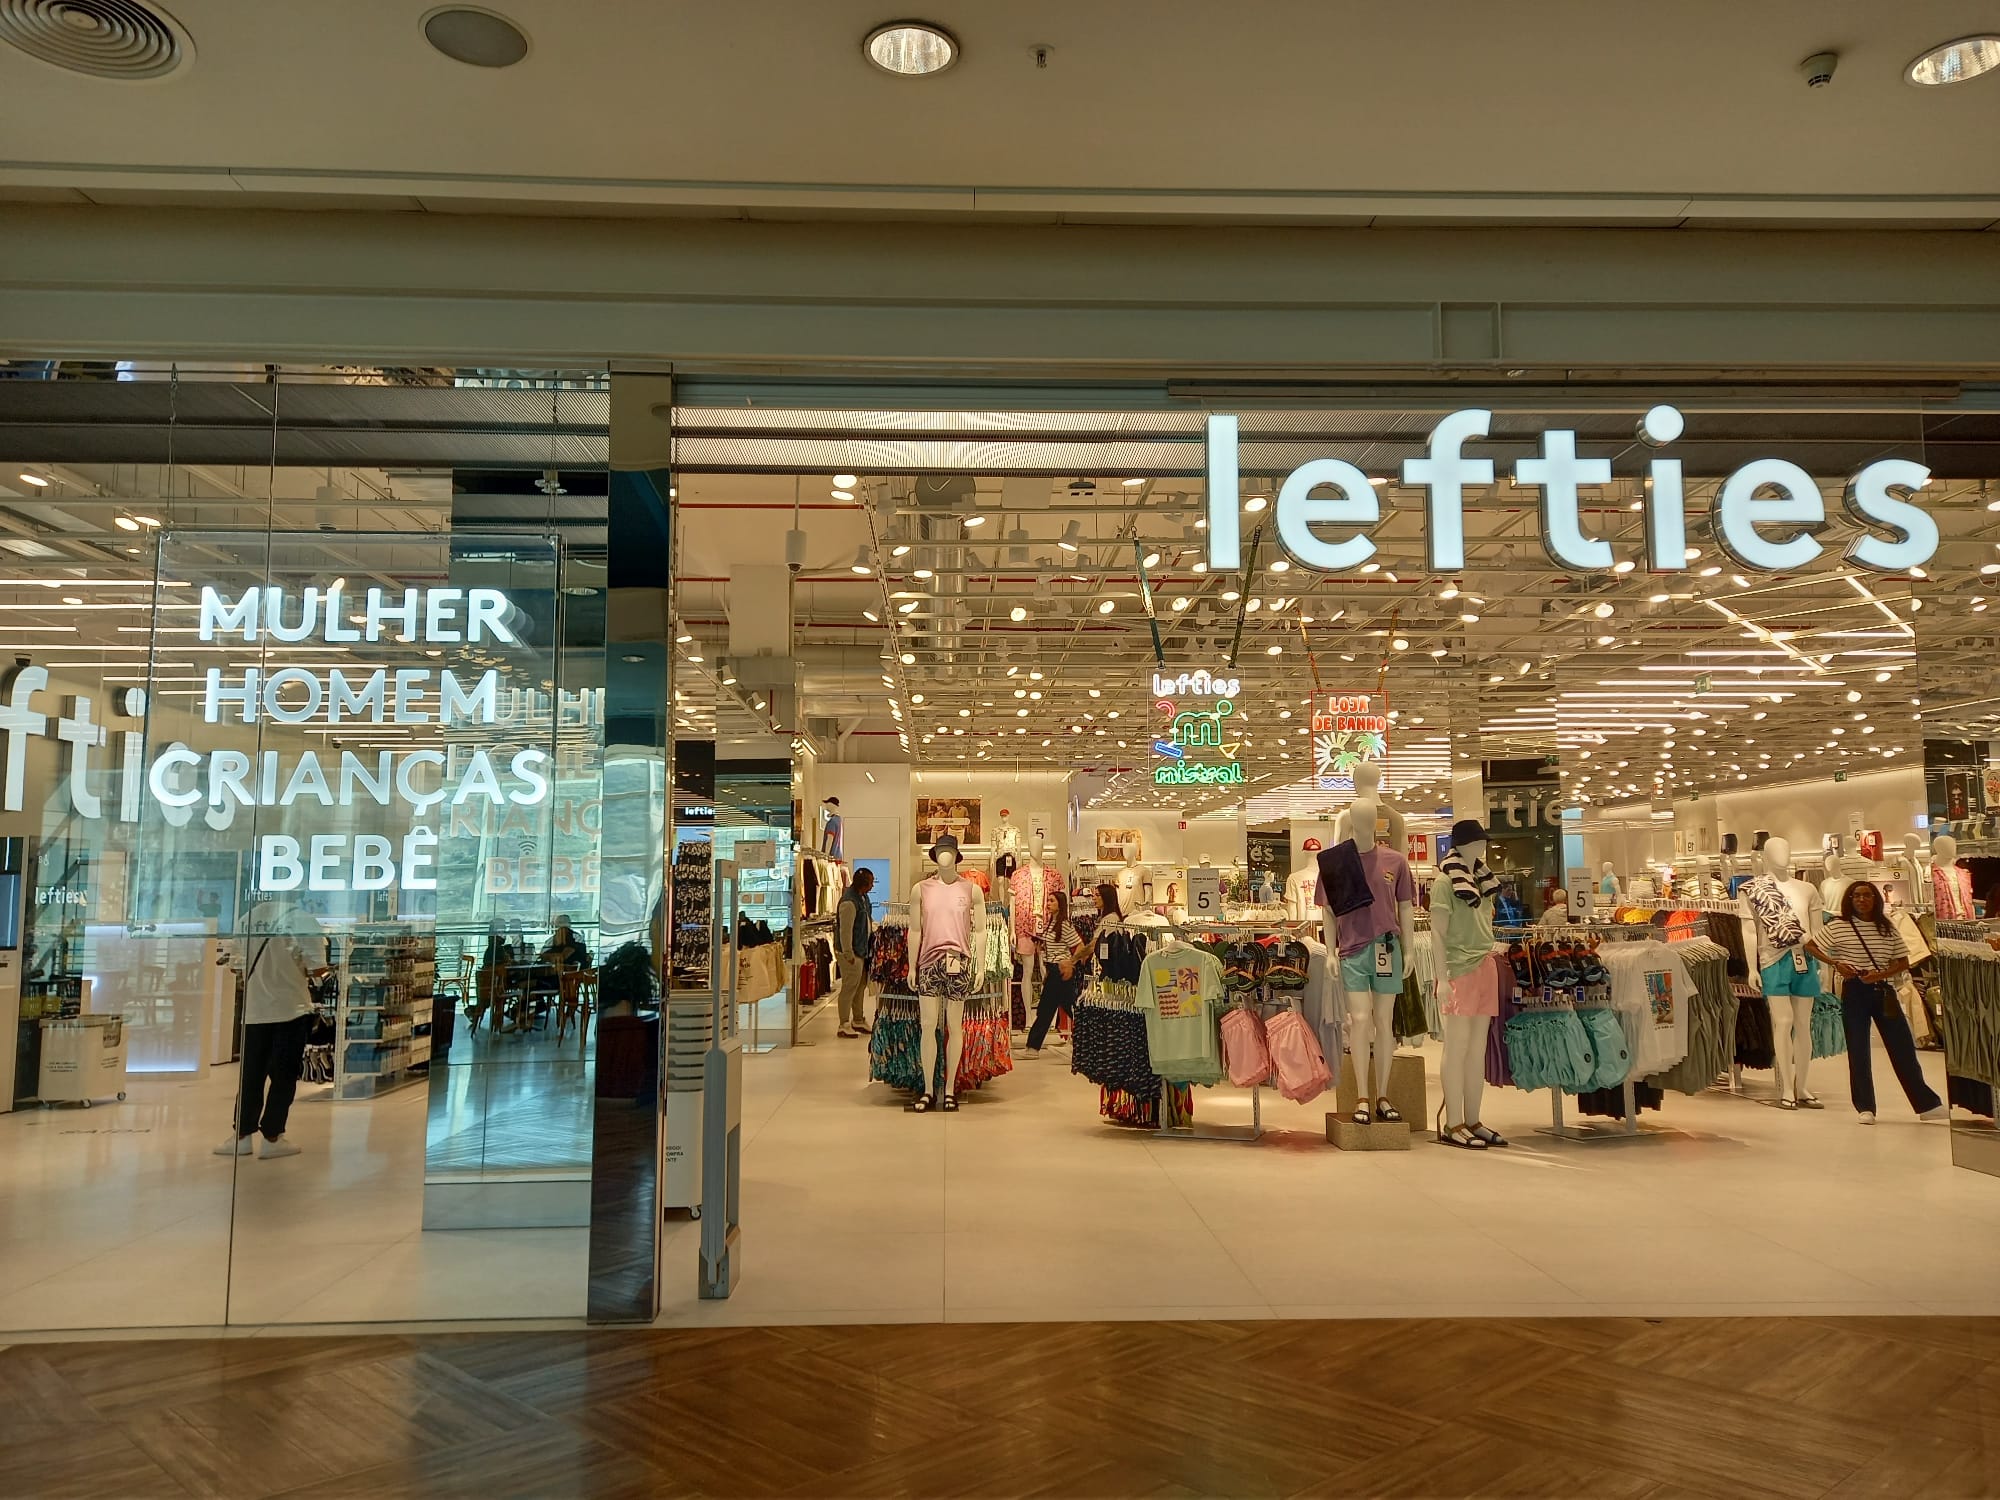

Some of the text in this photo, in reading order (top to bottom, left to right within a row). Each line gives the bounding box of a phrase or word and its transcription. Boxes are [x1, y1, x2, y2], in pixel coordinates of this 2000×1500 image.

[1205, 405, 1940, 572] lefties
[199, 586, 514, 643] MULHER
[204, 668, 497, 723] HOMEM
[1152, 673, 1240, 697] lefties
[1329, 695, 1369, 714] LOJA
[1312, 715, 1387, 732] DE BANHO
[149, 749, 548, 816] CRIANÇAS
[1155, 759, 1243, 785] mistral
[259, 825, 438, 892] BEBÊ
[1197, 891, 1210, 909] 5
[1576, 890, 1586, 908] 5
[1378, 952, 1387, 967] 5
[1796, 954, 1803, 967] 5
